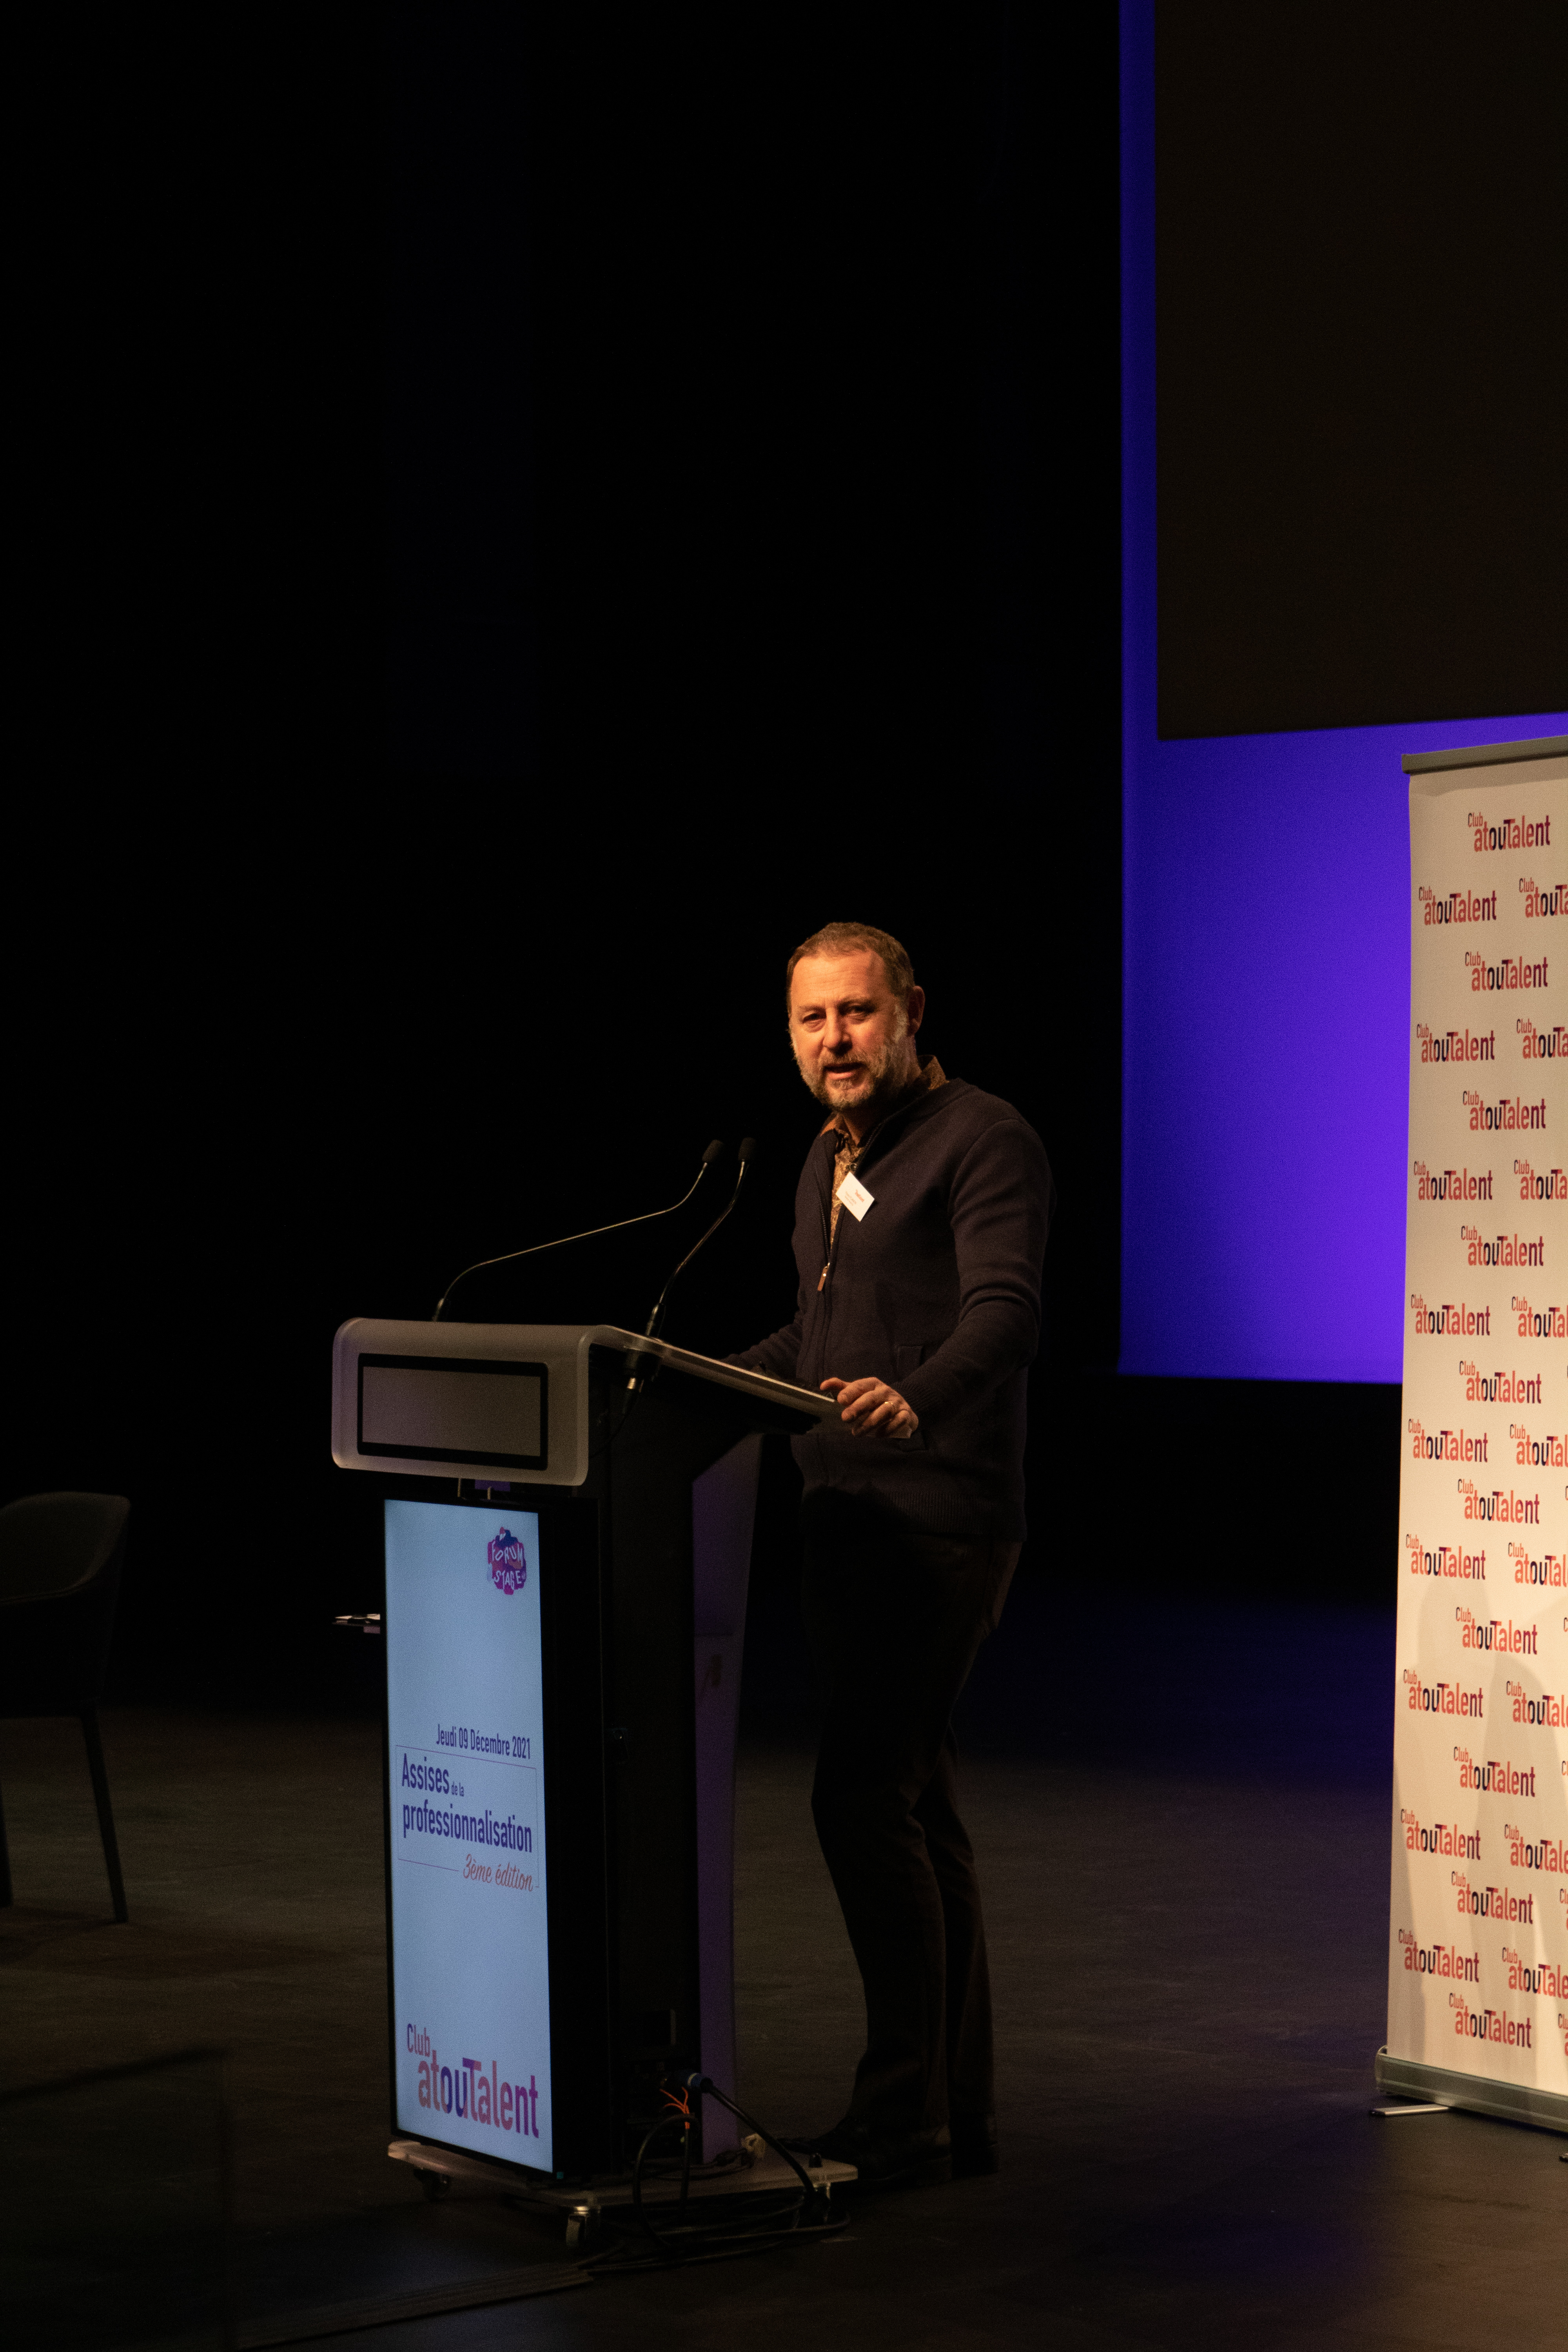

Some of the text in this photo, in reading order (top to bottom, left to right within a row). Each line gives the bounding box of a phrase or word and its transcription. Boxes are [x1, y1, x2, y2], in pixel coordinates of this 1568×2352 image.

[1468, 812, 1483, 827] Club
[1474, 815, 1550, 852] atouTalent
[1419, 887, 1432, 900] Club
[1519, 878, 1534, 893] Club
[1425, 890, 1497, 925] atouTalent
[1465, 952, 1481, 966] Club
[1472, 956, 1548, 991] atouTalent
[1417, 1024, 1429, 1038] Club
[1516, 1019, 1532, 1033] Club
[1422, 1029, 1495, 1063] atouTalent
[1463, 1091, 1479, 1105] Club
[1470, 1097, 1546, 1131] atouTalent
[1414, 1161, 1426, 1175] Club
[1514, 1160, 1529, 1174] Club
[1419, 1168, 1493, 1200] atouTalent
[1461, 1225, 1477, 1240] Club
[1468, 1234, 1544, 1266] atouTalent
[1412, 1294, 1423, 1308] Club
[1512, 1296, 1527, 1311] Club
[1416, 1303, 1490, 1336] atouTalent
[1459, 1361, 1475, 1376] Club
[1466, 1370, 1541, 1404] atouTalent
[1409, 1419, 1421, 1433] Club
[1510, 1424, 1525, 1439] Club
[1414, 1429, 1488, 1463] atouTalent
[1458, 1479, 1473, 1494] Club
[1465, 1490, 1540, 1524] atouTalent
[1406, 1534, 1419, 1549] Club
[1508, 1542, 1524, 1557] Club
[492, 1541, 523, 1566] FORUM
[1411, 1545, 1486, 1580] atouTalent
[1515, 1554, 1568, 1587] atouTal
[492, 1570, 522, 1590] STAGE
[1456, 1607, 1471, 1622] Club
[1463, 1619, 1537, 1655] atouTalent
[1404, 1669, 1417, 1684] Club
[1506, 1681, 1521, 1697] Club
[1409, 1681, 1483, 1718] atouTalent
[436, 1724, 530, 1759] Jeudi 09 Décembre 2021
[1454, 1746, 1468, 1762] Club
[402, 1753, 464, 1797] Assises de la
[1460, 1759, 1535, 1797] atouTalent
[1401, 1809, 1414, 1824] Club
[403, 1799, 532, 1853] professionnalisation
[1504, 1824, 1519, 1840] Club
[1407, 1821, 1481, 1860] atouTalent
[463, 1853, 533, 1891] 3ème édition
[1452, 1871, 1466, 1887] Club
[1457, 1884, 1533, 1924] atouTalent
[1399, 1929, 1413, 1945] Club
[1405, 1942, 1479, 1983] atouTalent
[1502, 1947, 1517, 1964] Club
[1449, 1993, 1463, 2009] Club
[1455, 2006, 1532, 2049] atouTalent
[407, 2023, 430, 2057] Club
[418, 2050, 539, 2139] atouTalent
